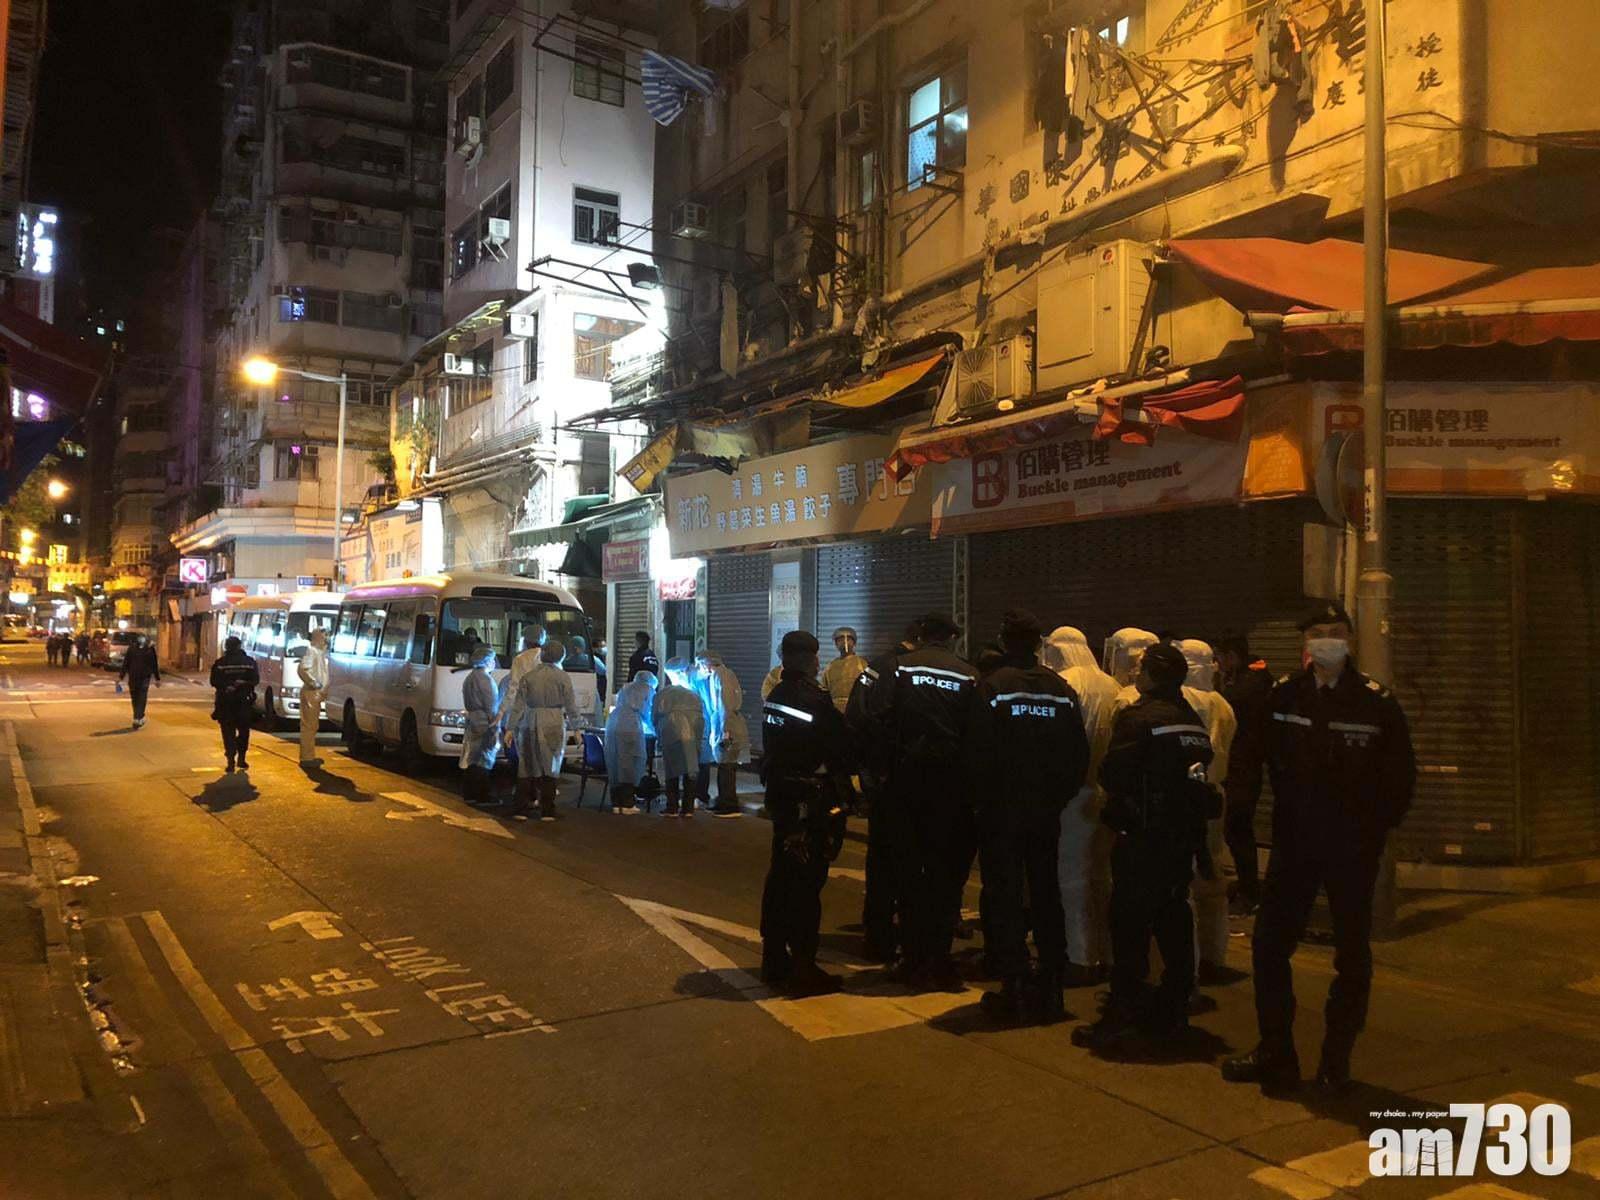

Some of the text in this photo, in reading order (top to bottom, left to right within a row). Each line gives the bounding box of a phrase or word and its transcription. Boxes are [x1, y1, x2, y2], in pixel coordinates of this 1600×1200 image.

[1415, 31, 1444, 92] 授徒
[1447, 436, 1561, 451] management
[1016, 459, 1183, 499] Buckle management
[424, 981, 560, 1039] LEFT
